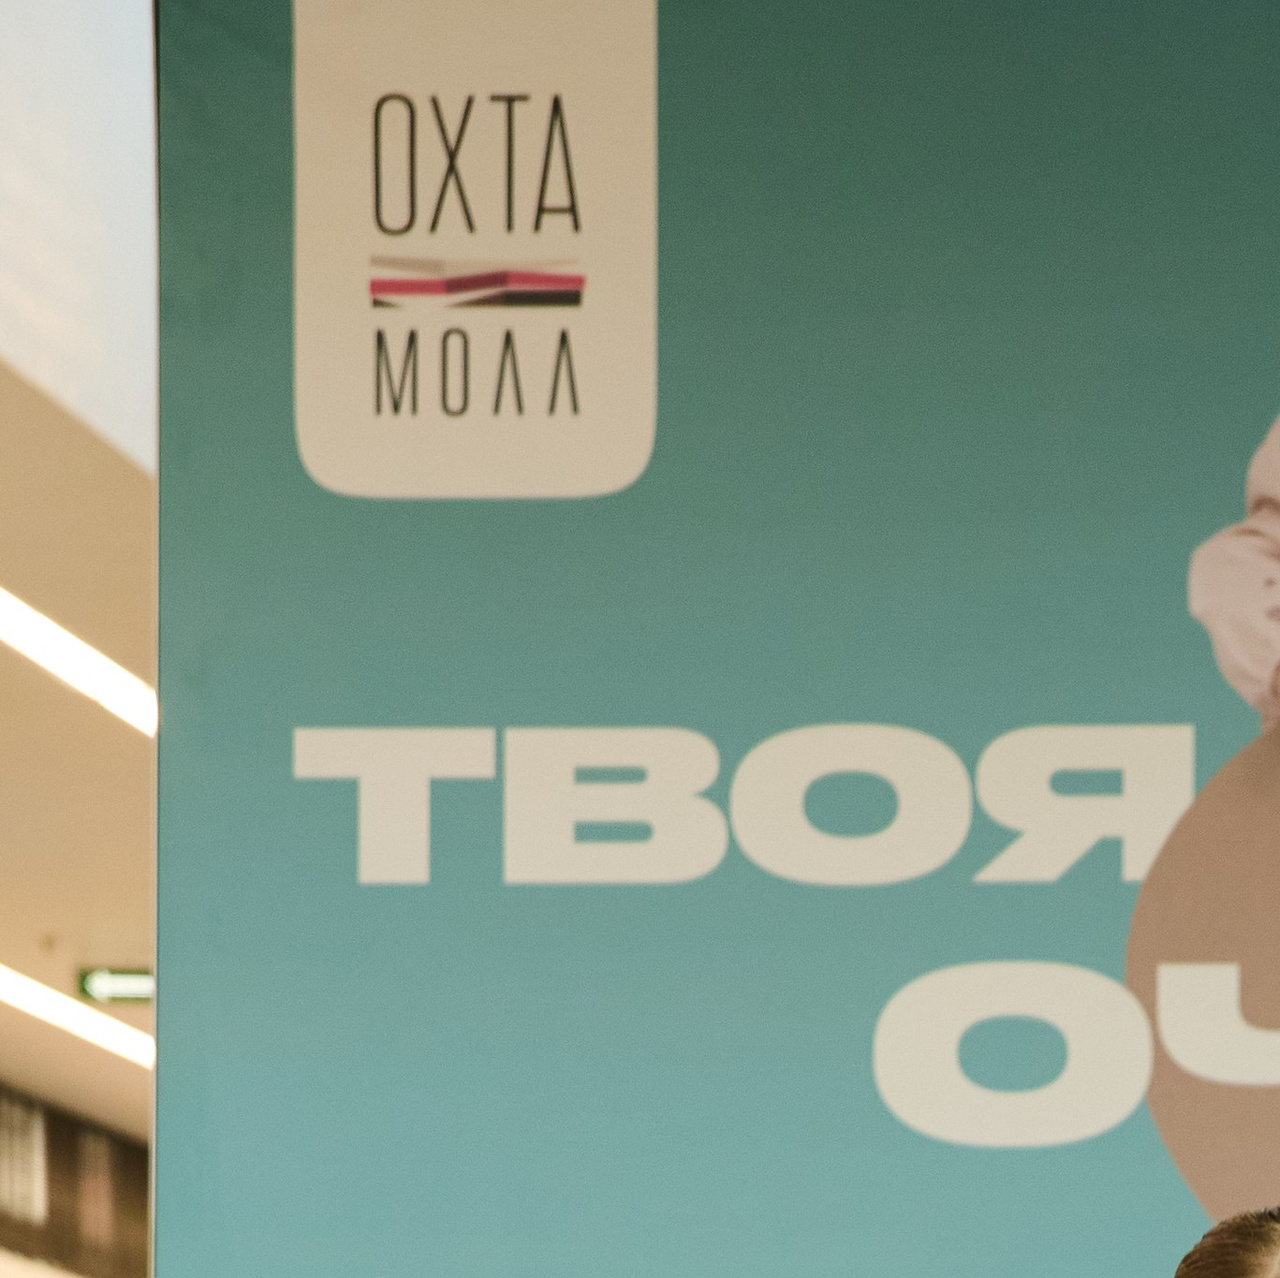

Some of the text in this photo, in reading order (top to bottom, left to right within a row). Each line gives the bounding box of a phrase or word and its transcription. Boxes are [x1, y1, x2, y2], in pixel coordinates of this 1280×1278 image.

[373, 93, 582, 236] ОХТА
[374, 327, 581, 417] МОЛЛ
[293, 722, 1196, 887] ТВОЯ
